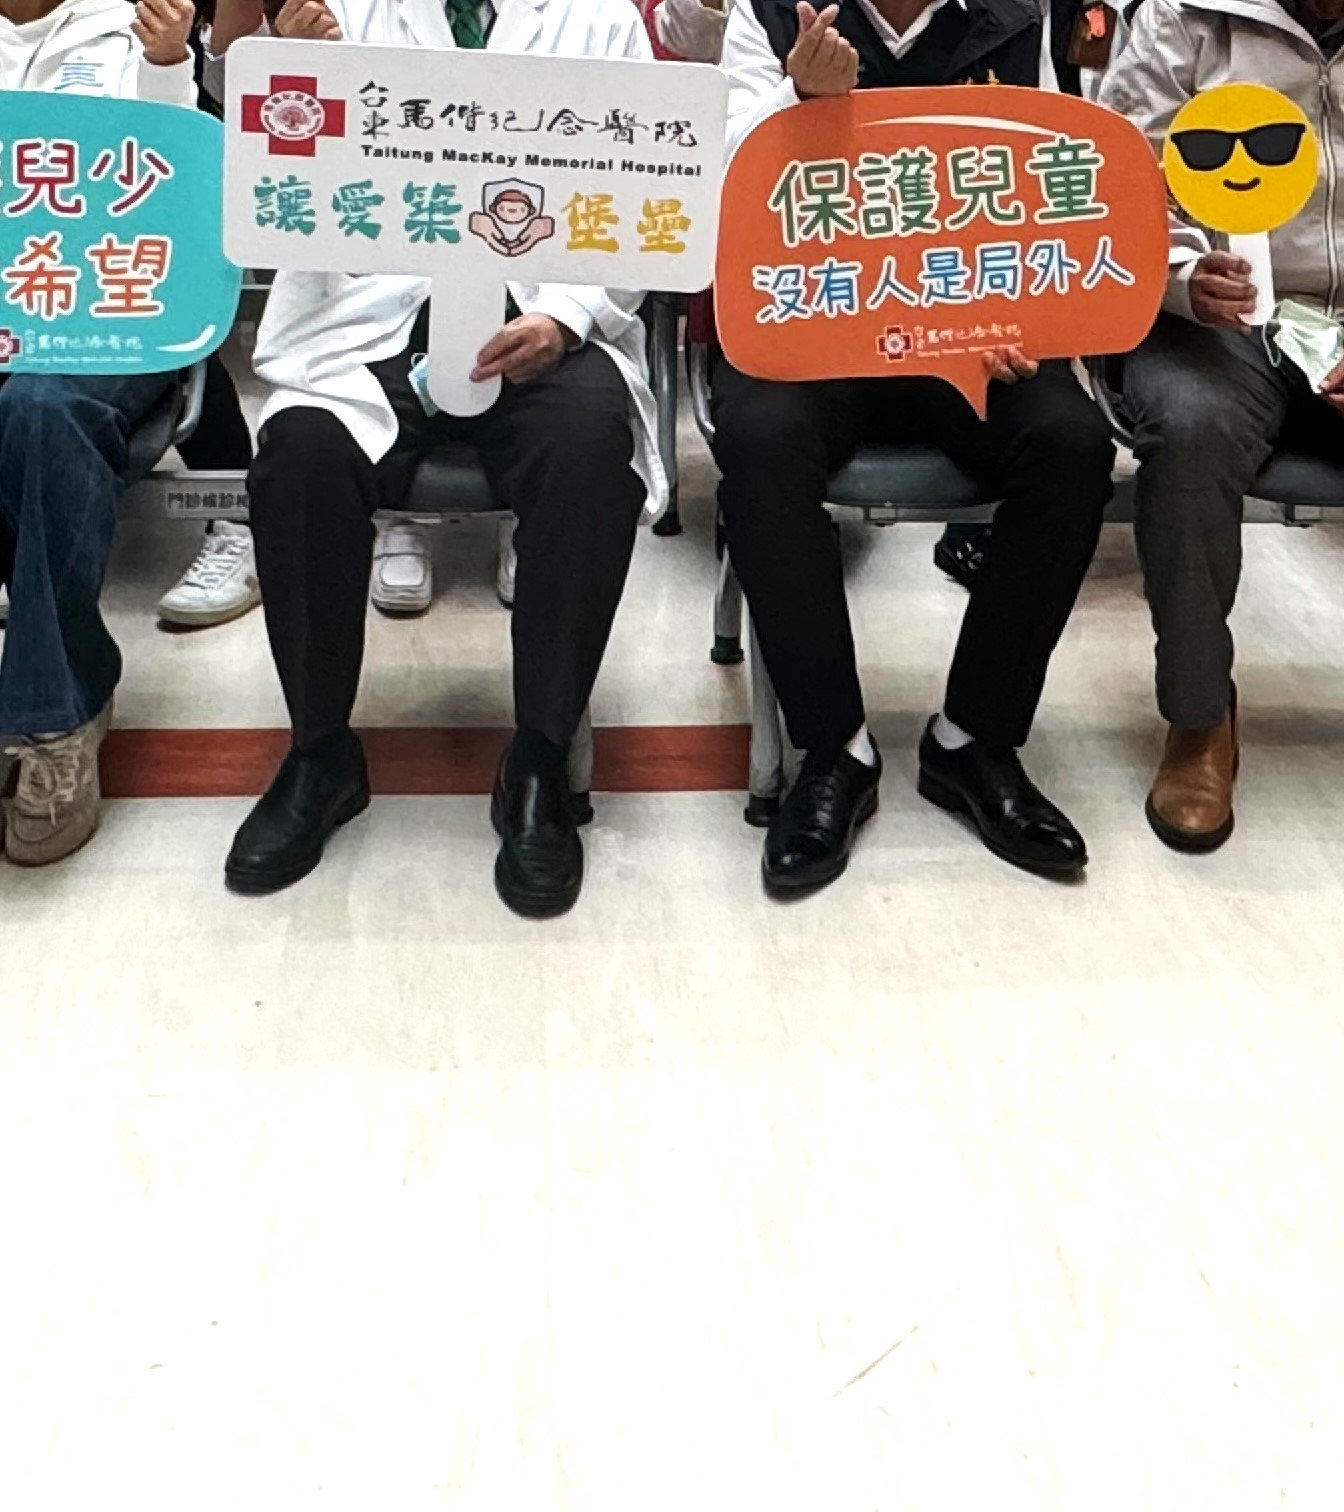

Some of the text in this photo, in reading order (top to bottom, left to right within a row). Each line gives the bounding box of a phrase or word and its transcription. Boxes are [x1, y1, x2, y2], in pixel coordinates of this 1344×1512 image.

[361, 145, 702, 178] Taitung MacKay Memorial Hospital
[767, 134, 1109, 248] 保護兒童
[254, 175, 692, 255] 讓愛築 堡壘
[752, 235, 1137, 325] 沒有人是局外人
